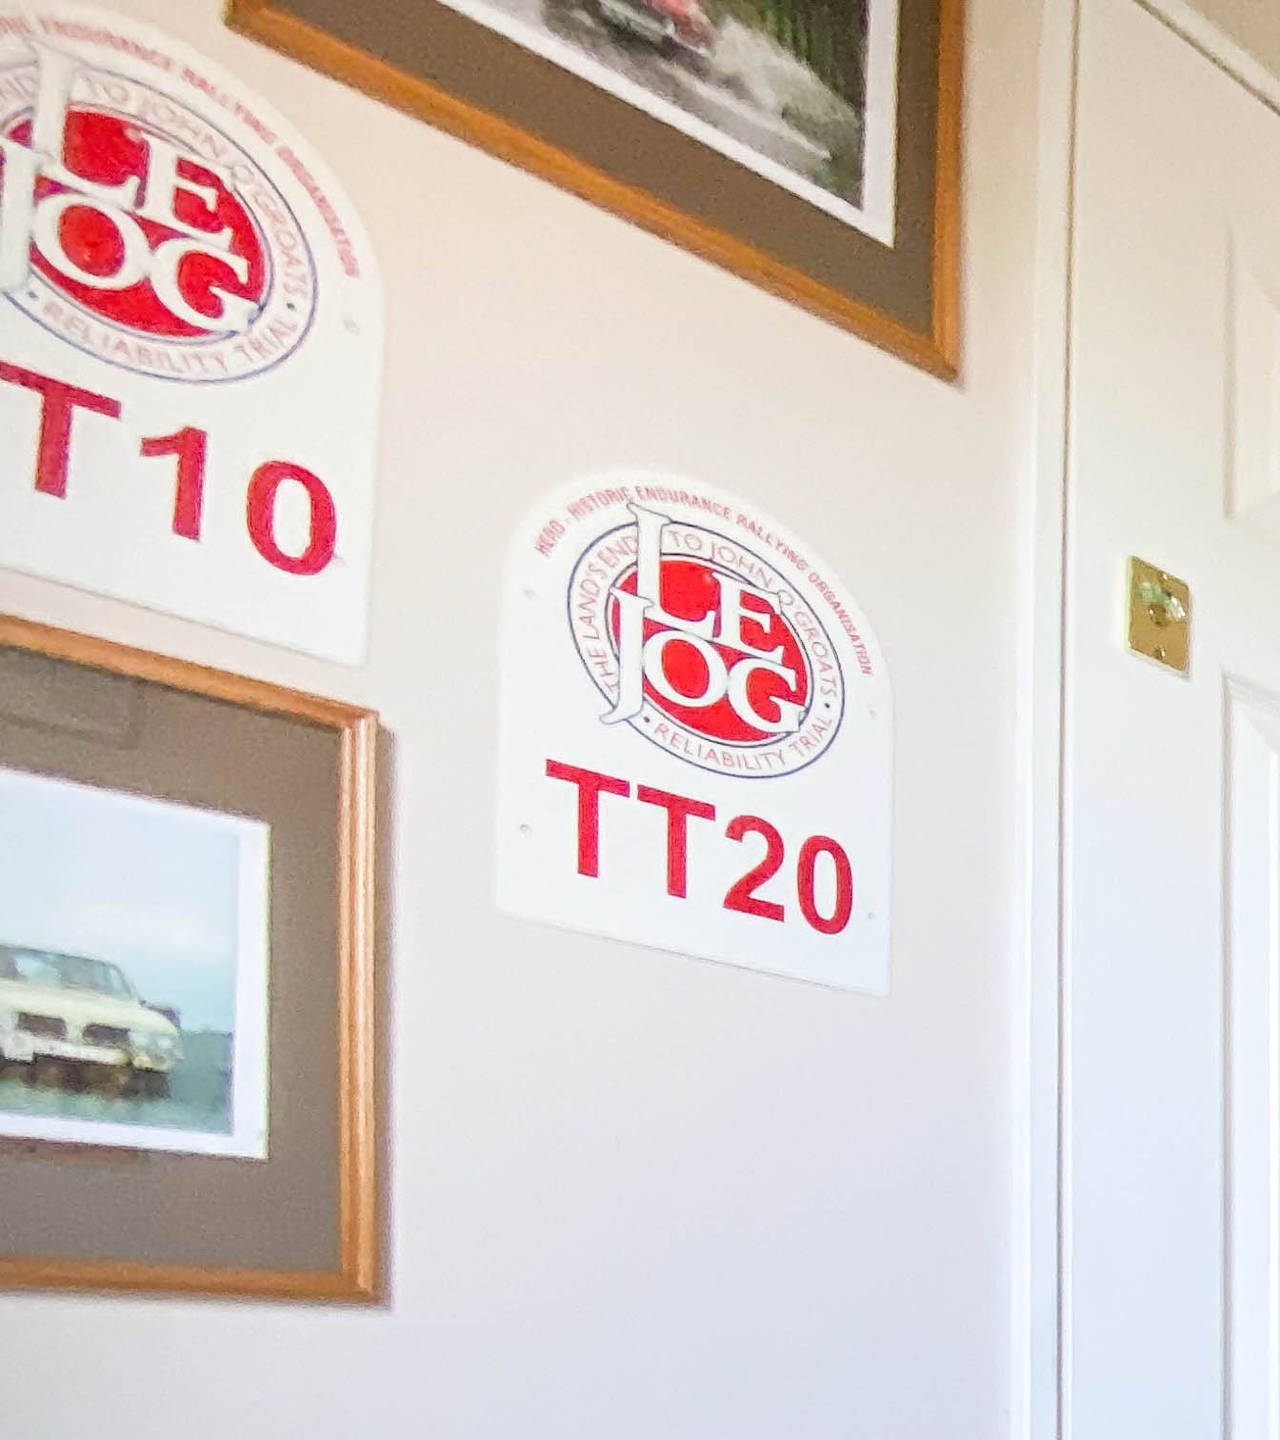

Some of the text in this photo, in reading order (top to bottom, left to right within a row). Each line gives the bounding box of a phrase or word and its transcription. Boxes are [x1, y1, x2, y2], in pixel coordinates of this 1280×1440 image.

[634, 485, 732, 521] ENDURANCE
[736, 513, 809, 572] RALLYING
[807, 571, 873, 676] ORGANISATION
[667, 529, 704, 552] TO
[711, 540, 774, 588] JOHN
[653, 717, 833, 771] RELIABILITY TRIAL
[545, 758, 854, 935] TT20
